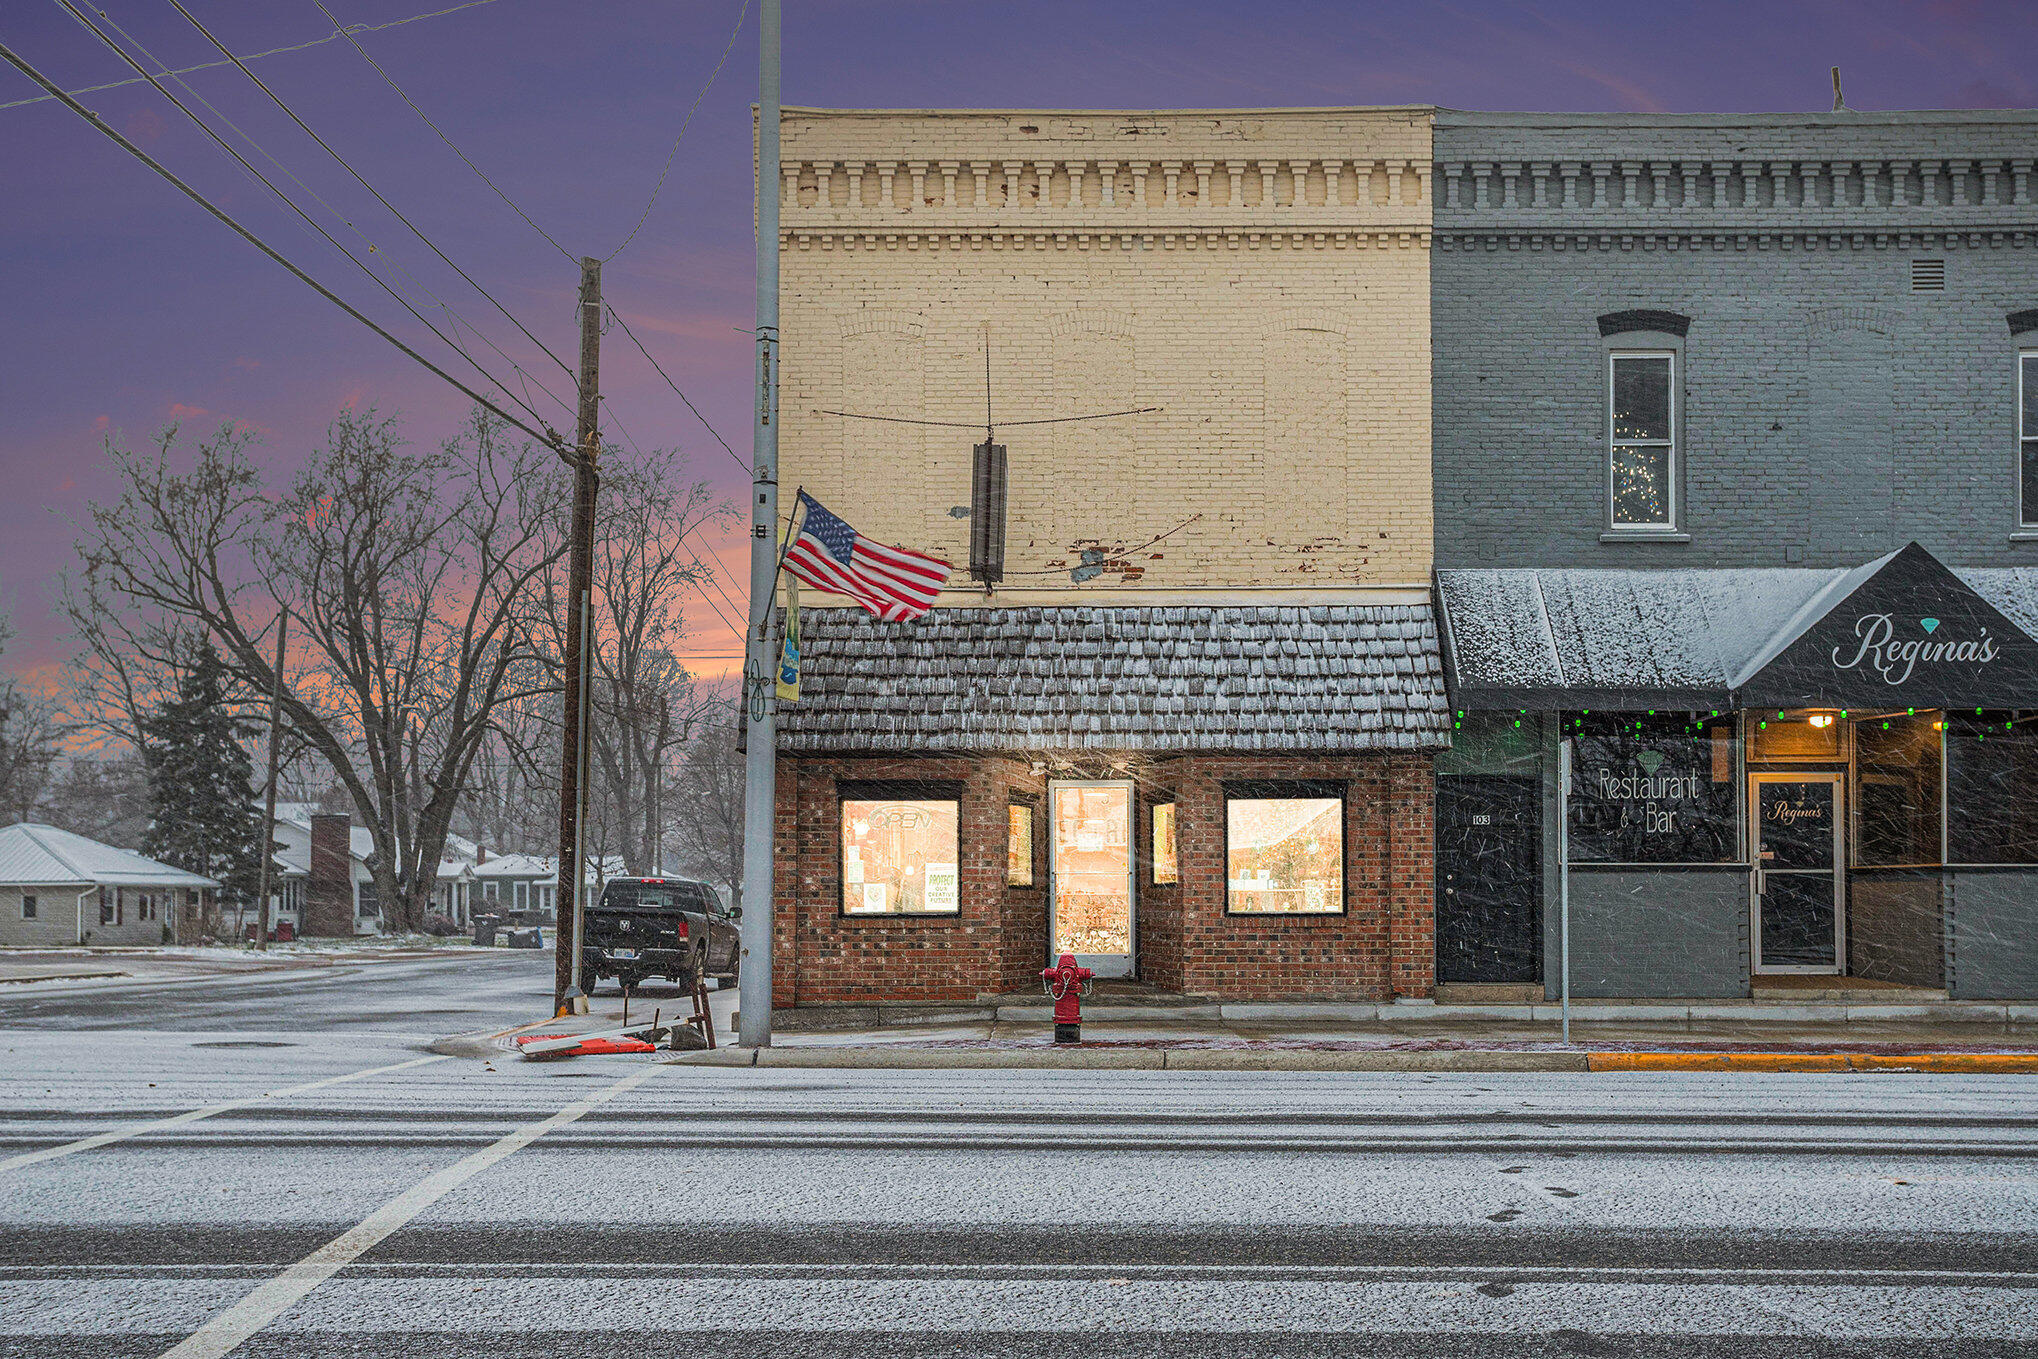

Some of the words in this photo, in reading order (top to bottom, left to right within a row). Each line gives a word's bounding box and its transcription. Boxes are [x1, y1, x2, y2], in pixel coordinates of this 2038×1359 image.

[1832, 613, 2000, 685] Regina's
[1600, 768, 1699, 799] Restaurant
[869, 811, 933, 829] OPEN
[1473, 815, 1490, 824] 103
[1646, 802, 1677, 833] Bar
[1766, 800, 1822, 826] Regina's
